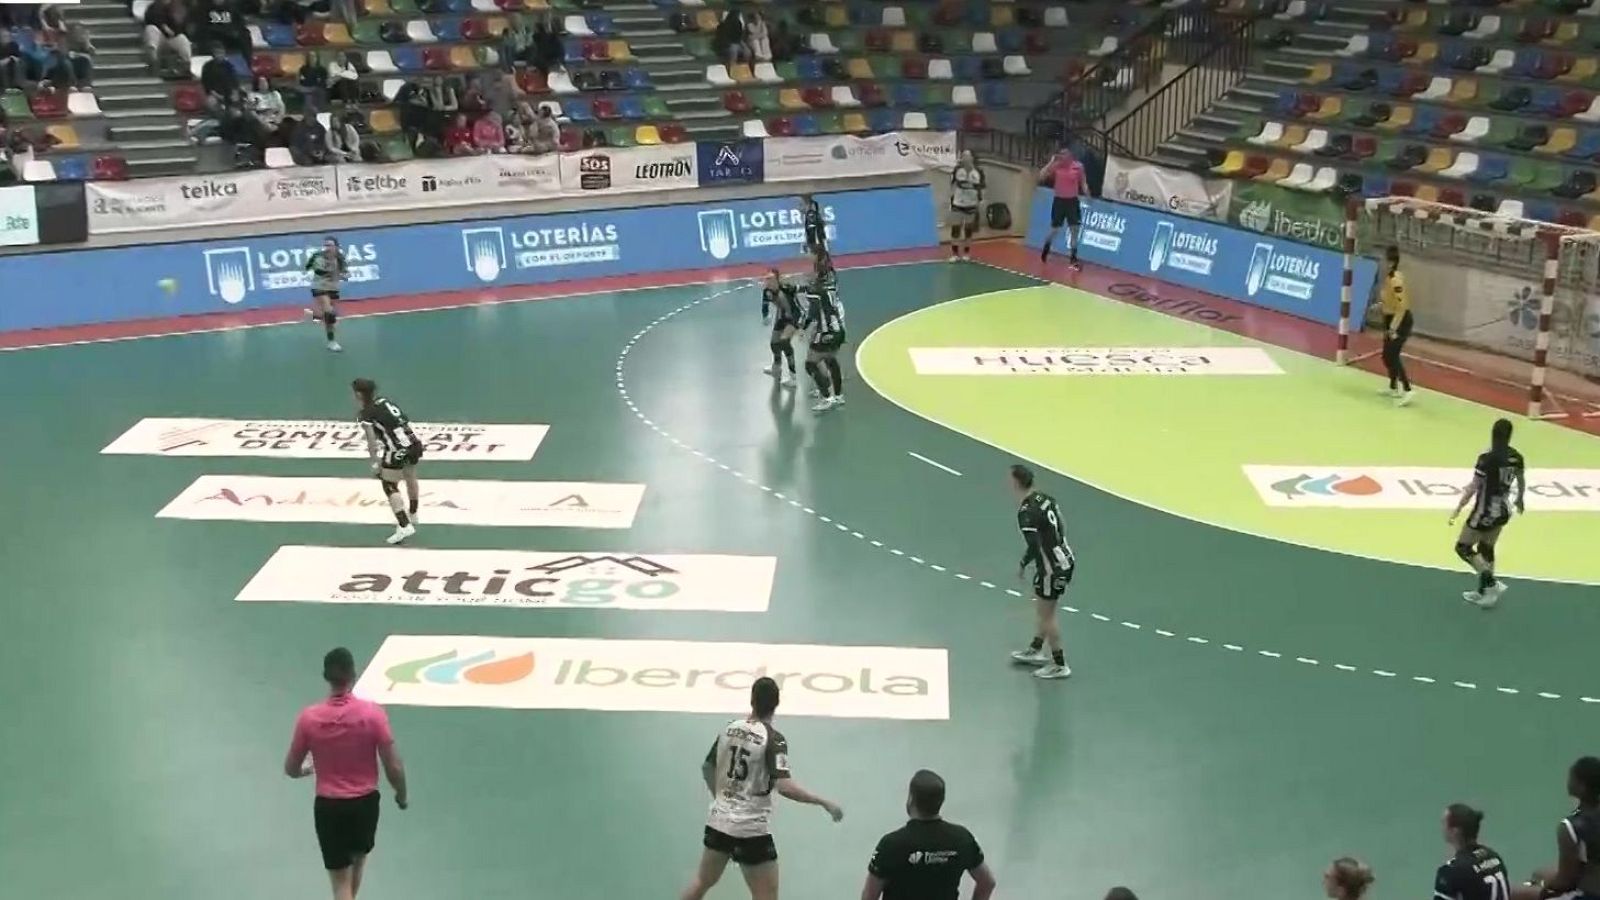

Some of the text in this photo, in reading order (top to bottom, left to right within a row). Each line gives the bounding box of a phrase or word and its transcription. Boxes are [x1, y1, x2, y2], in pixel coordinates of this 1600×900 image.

[635, 161, 692, 179] LEOTRON
[181, 180, 238, 199] teika
[364, 174, 407, 191] elche
[1125, 190, 1155, 205] ribera
[740, 206, 836, 228] LOTERS
[511, 222, 618, 248] LOTERÍAS
[1172, 231, 1219, 256] LOTERÍAS
[1270, 252, 1321, 280] LOTERÍAS
[385, 402, 401, 417] 6
[1047, 510, 1061, 541] 9
[554, 659, 929, 697] Iberdrola
[725, 745, 751, 781] 15
